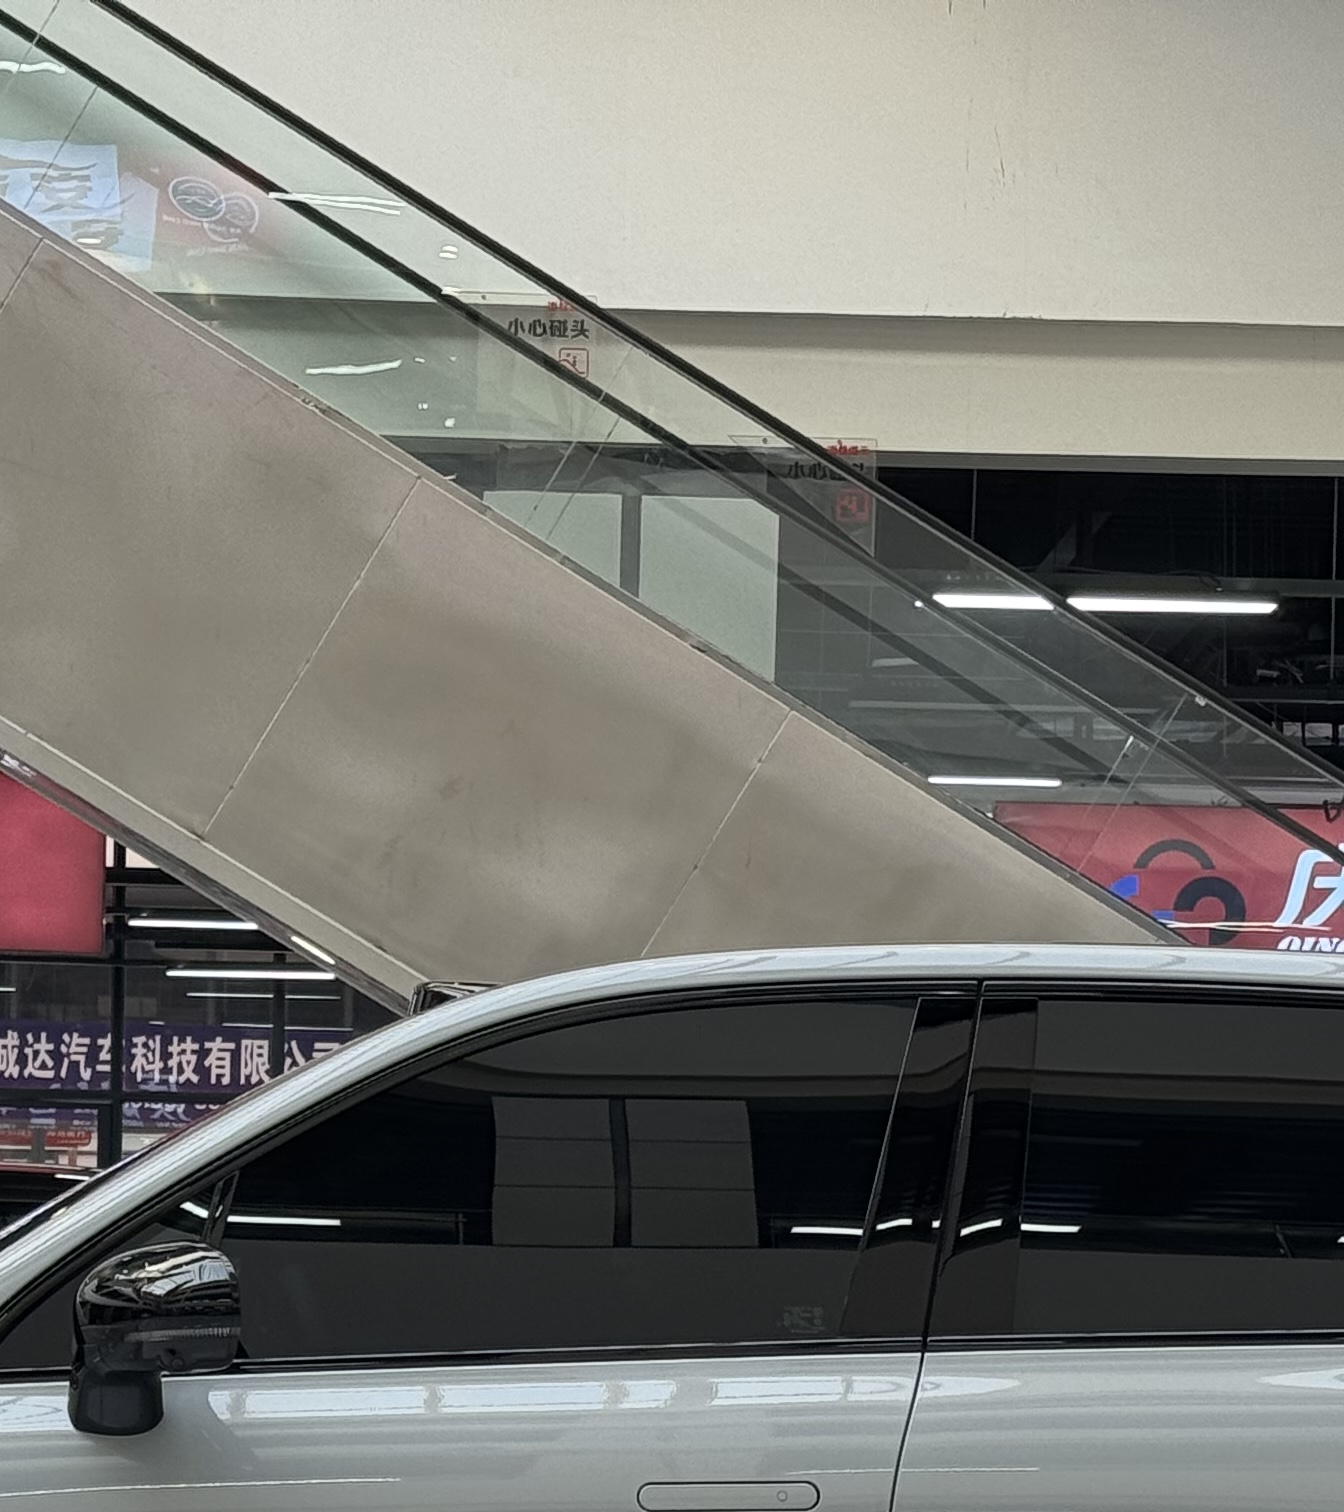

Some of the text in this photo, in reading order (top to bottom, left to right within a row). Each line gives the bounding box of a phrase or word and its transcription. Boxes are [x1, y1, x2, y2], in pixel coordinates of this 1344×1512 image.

[508, 318, 590, 340] 小心碰头
[788, 461, 864, 480] 小心
